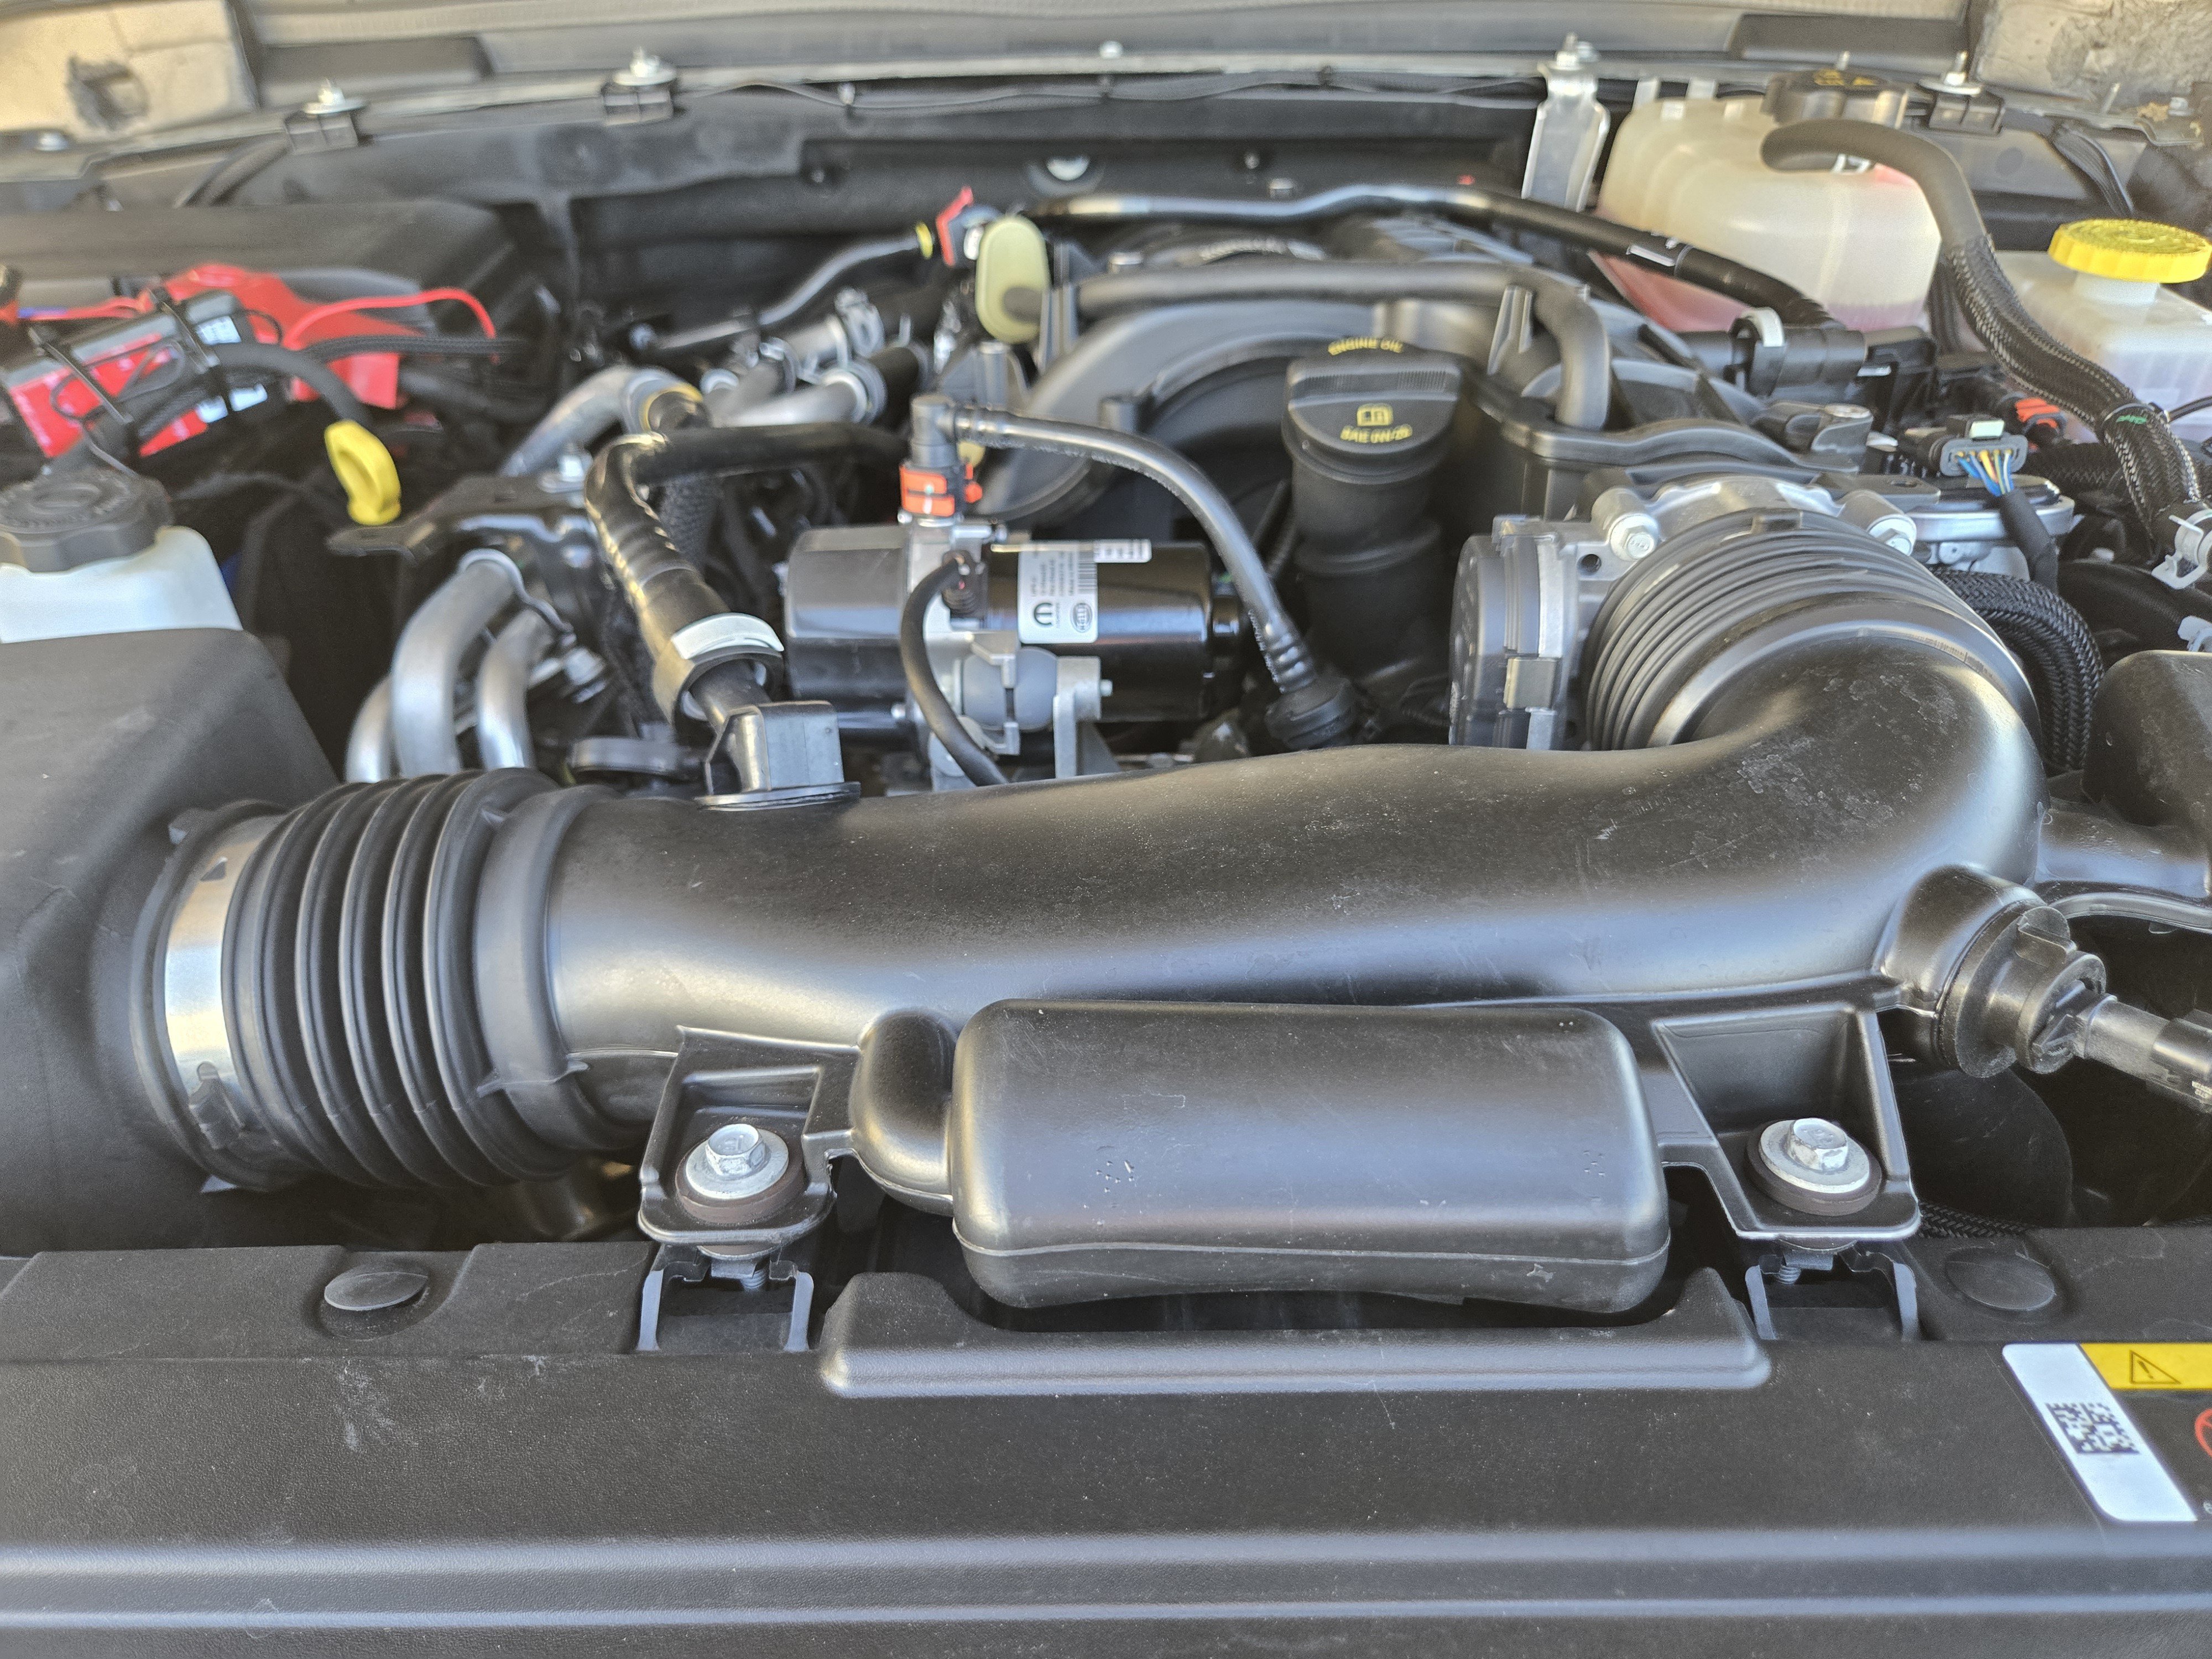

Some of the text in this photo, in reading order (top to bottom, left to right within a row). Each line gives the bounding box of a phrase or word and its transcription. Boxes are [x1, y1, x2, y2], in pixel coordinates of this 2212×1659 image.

[1328, 337, 1404, 355] ENGINE OIL
[1340, 425, 1370, 443] SAE
